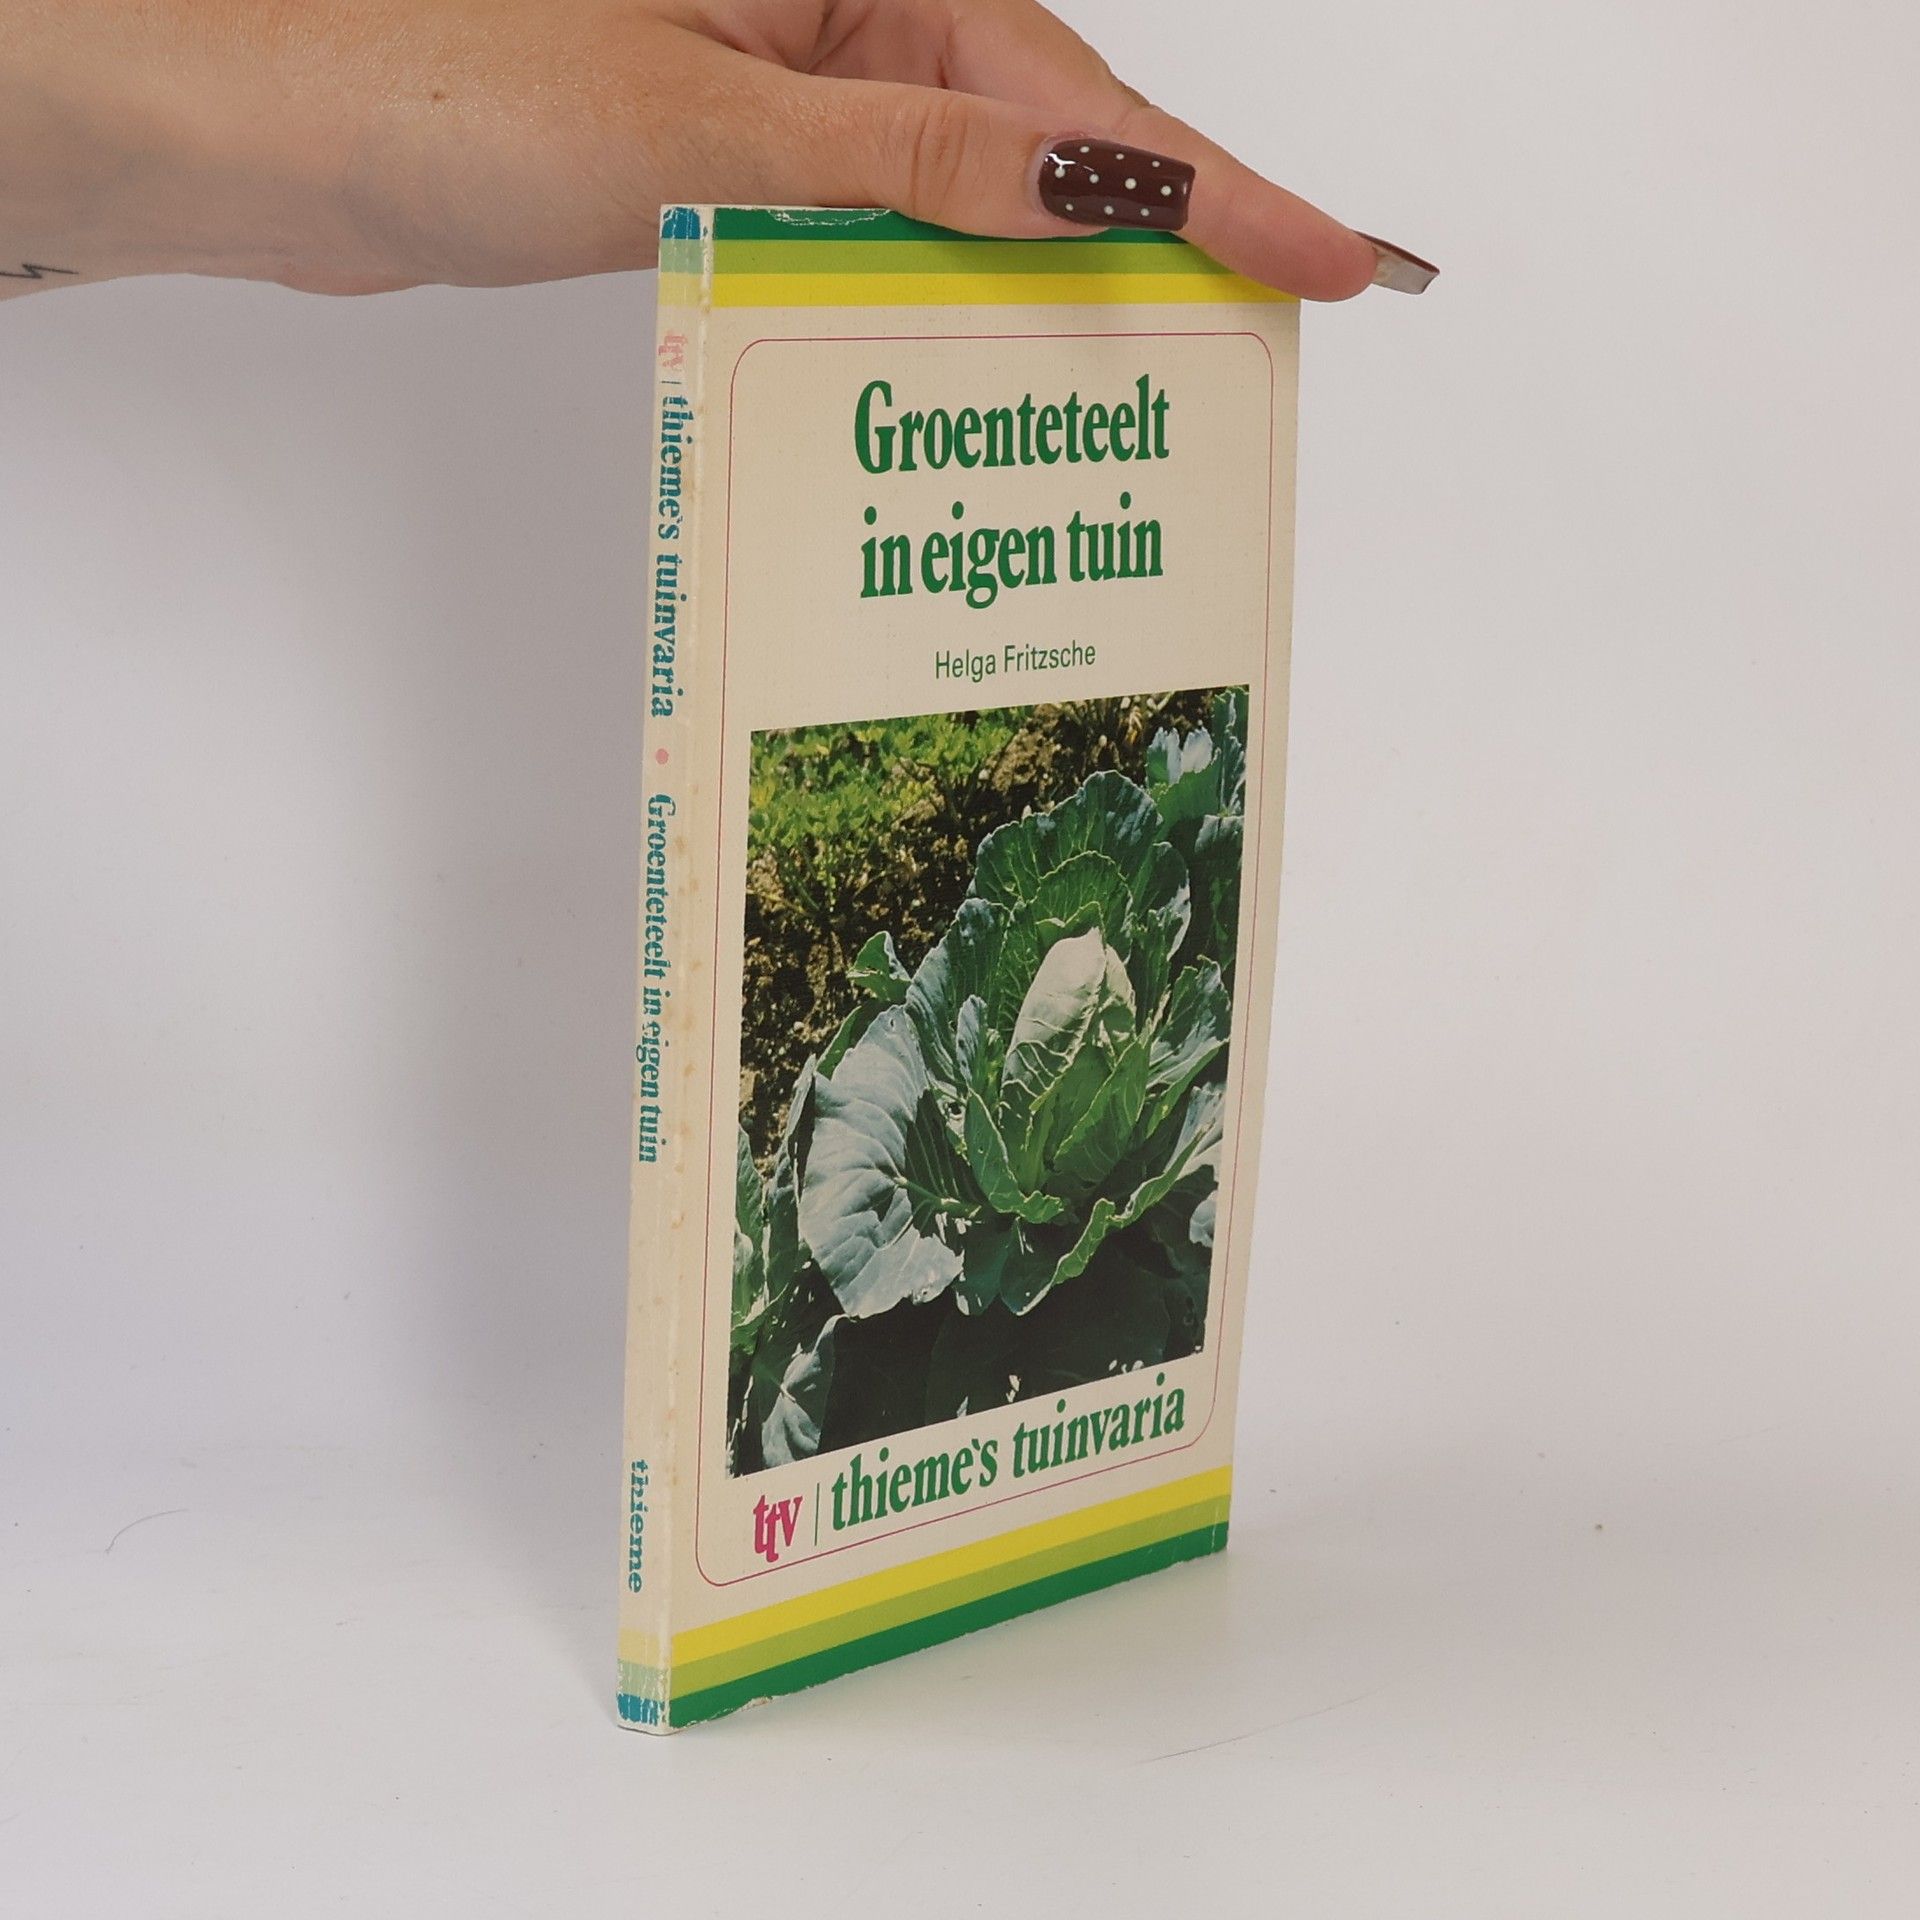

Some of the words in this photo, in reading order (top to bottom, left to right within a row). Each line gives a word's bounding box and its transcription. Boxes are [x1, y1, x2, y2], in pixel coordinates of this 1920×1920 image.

[854, 374, 1170, 474] Groenteteelt
[860, 506, 912, 598] in
[921, 501, 1056, 609] eigen
[1066, 492, 1163, 582] tuin
[651, 553, 687, 718] tuinvaria
[935, 648, 997, 682] Helga
[1003, 640, 1096, 673] Fritzsche
[644, 794, 676, 979] Groenteteelt
[643, 985, 671, 1015] in
[636, 1020, 669, 1098] eigen
[638, 1102, 667, 1163] tuin
[753, 1494, 803, 1562] ttv
[1012, 1372, 1186, 1477] tuinvaria
[628, 1459, 649, 1593] thieme
